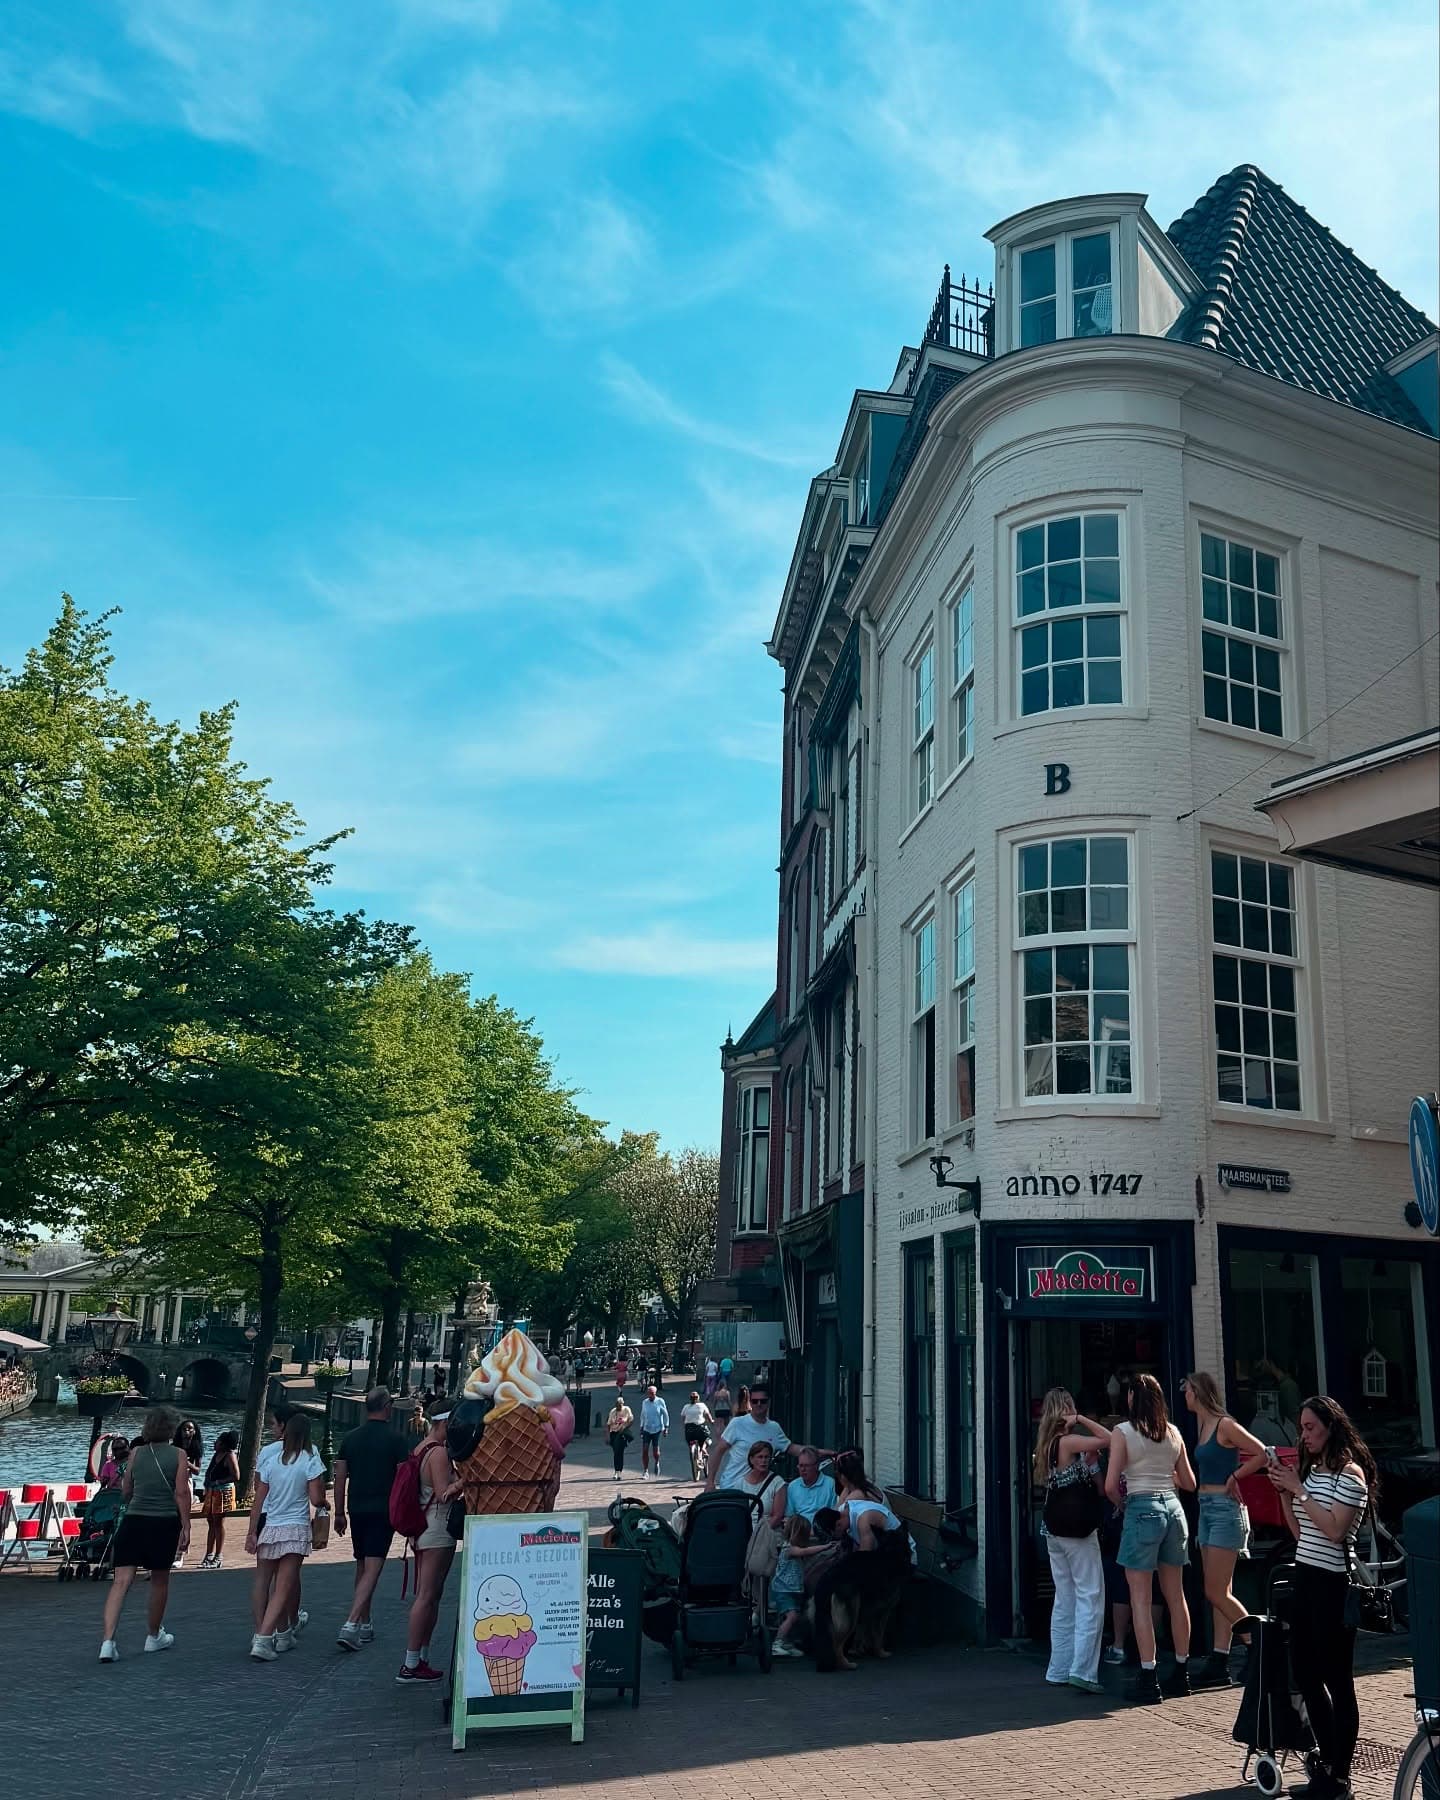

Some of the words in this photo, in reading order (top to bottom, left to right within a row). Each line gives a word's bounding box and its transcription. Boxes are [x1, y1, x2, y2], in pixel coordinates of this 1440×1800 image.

[1044, 763, 1071, 796] B
[1006, 1175, 1081, 1197] anno
[1089, 1174, 1143, 1195] 1747
[473, 1550, 531, 1566] COLLEGA'S
[586, 1574, 615, 1588] Alle
[588, 1594, 622, 1609] zza's
